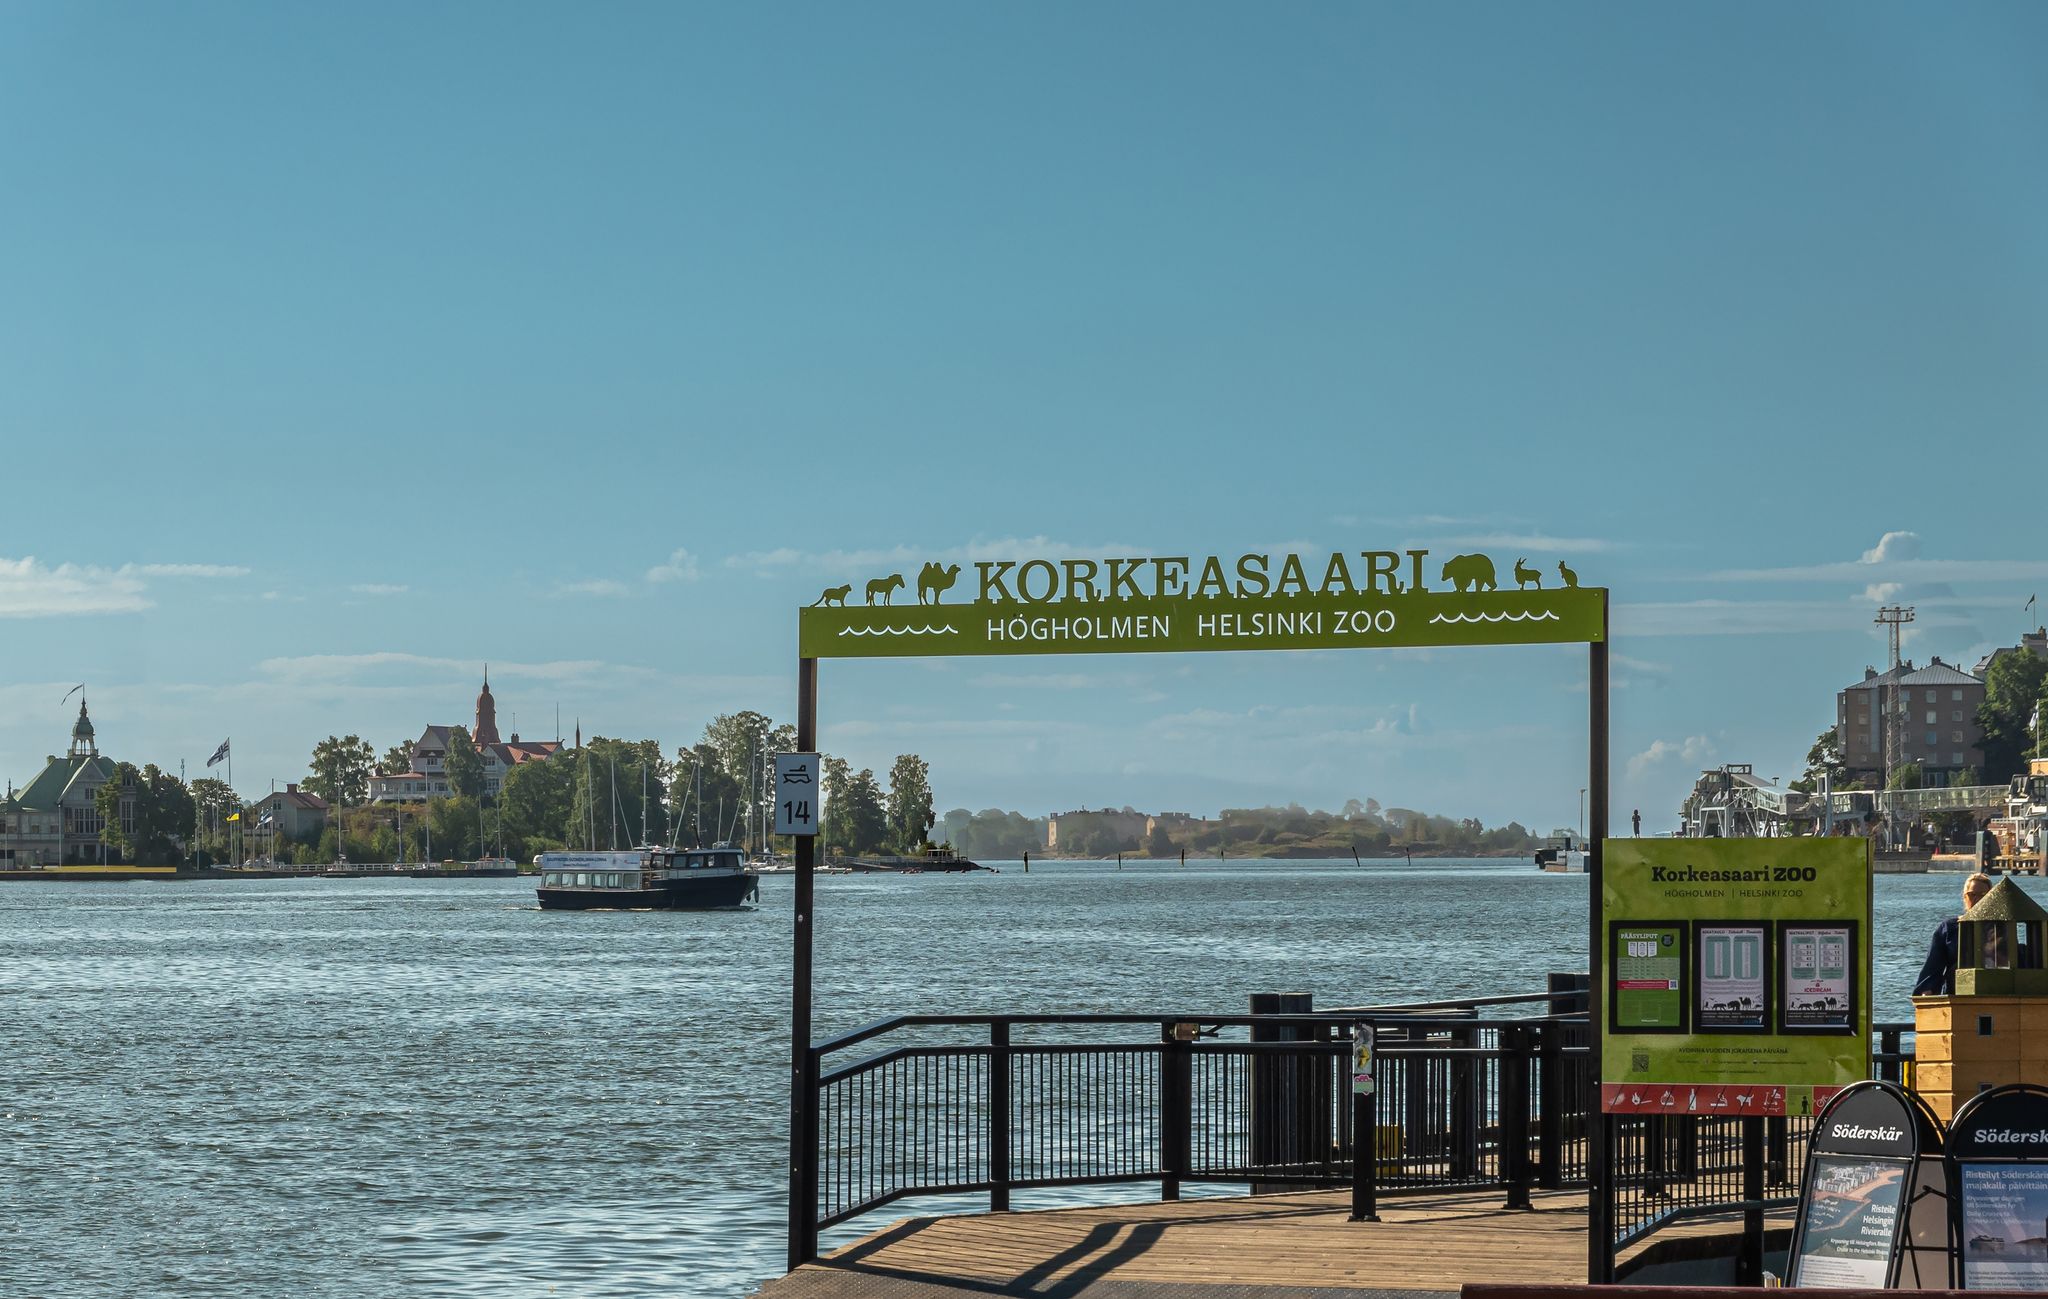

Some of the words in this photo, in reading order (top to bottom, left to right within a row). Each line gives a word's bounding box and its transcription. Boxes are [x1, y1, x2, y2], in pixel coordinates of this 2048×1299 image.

[974, 549, 1429, 603] KORKEASAARI
[987, 613, 1170, 641] HÖGHOLMEN
[1198, 610, 1322, 637] HELSINKI
[1333, 609, 1396, 634] ZOO
[783, 800, 811, 825] 14
[1651, 865, 1770, 883] Korkeasaari
[1773, 867, 1817, 883] ZOO
[1664, 887, 1726, 898] HÖGHOLMEN
[1739, 889, 1780, 898] HELSINKI
[1782, 889, 1804, 898] ZOO
[1831, 1123, 1904, 1142] Söderskär
[1974, 1128, 2048, 1143] Södersk
[1965, 1170, 2000, 1181] Risteilyt
[1966, 1182, 2007, 1191] majakalle
[1871, 1204, 1896, 1215] Risteile
[1862, 1215, 1894, 1228] Helsingin
[1860, 1226, 1893, 1237] Rivieralle
